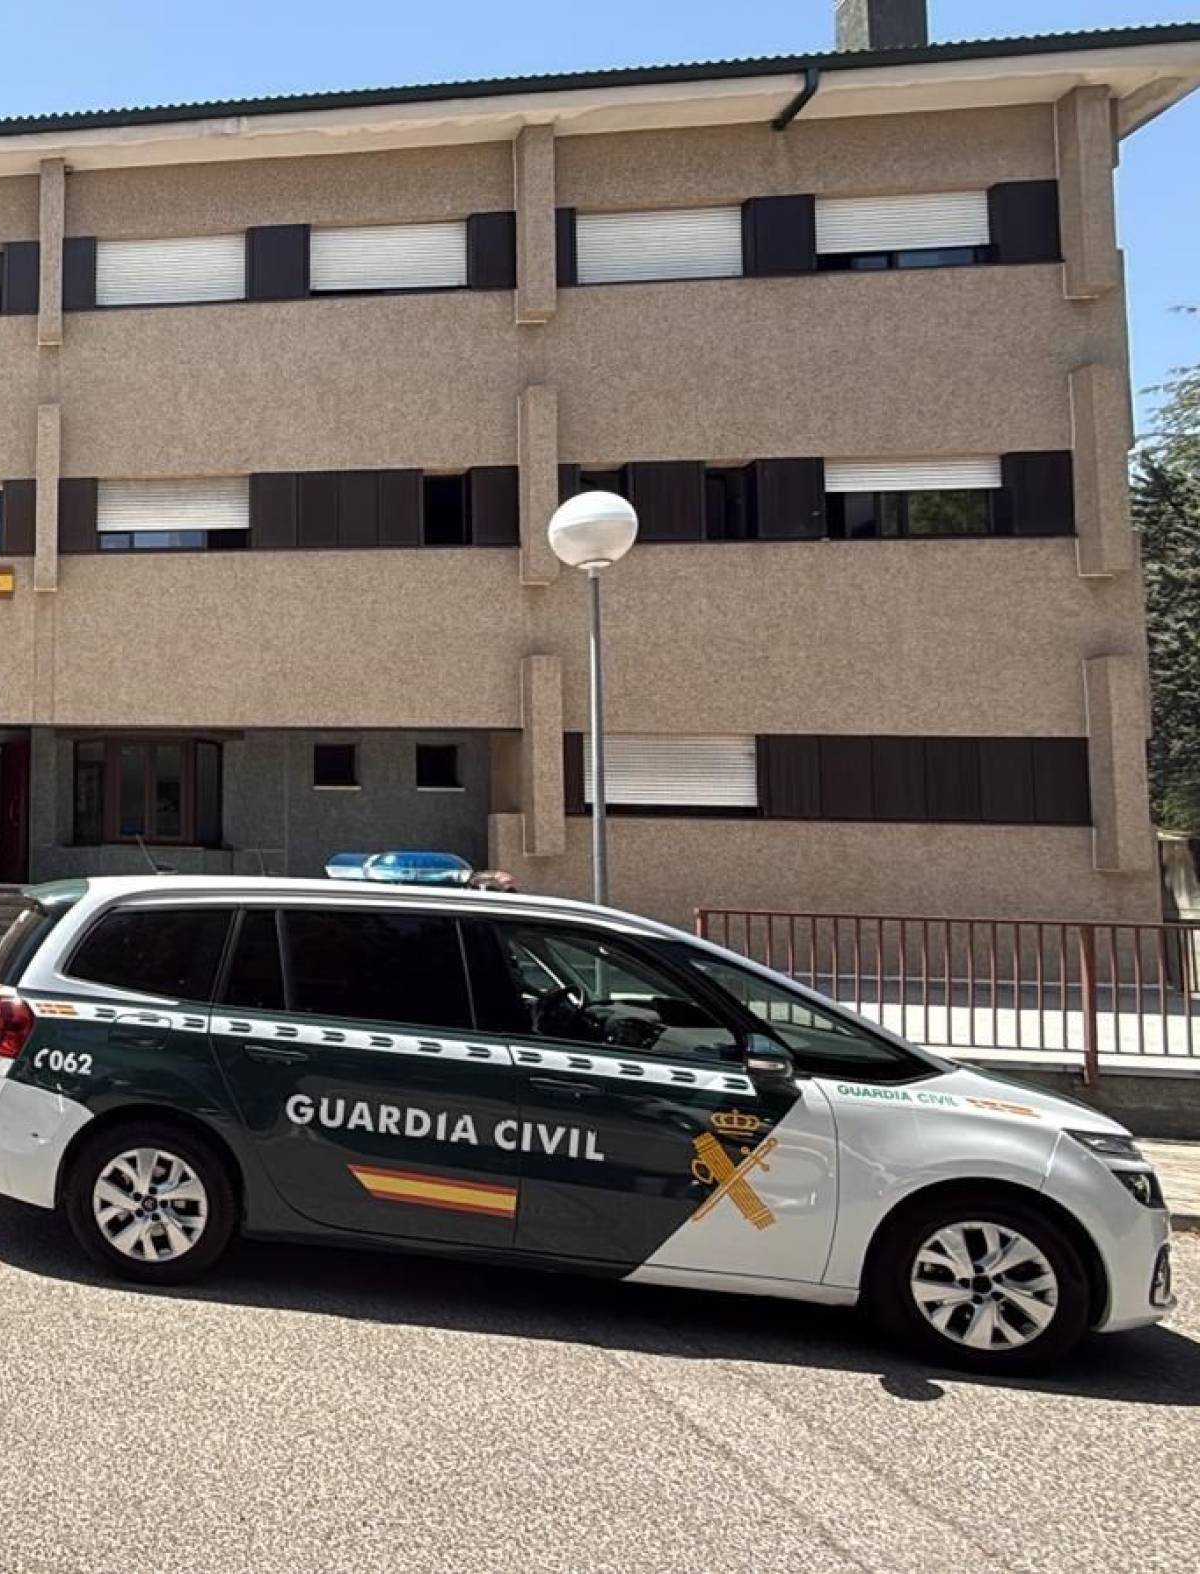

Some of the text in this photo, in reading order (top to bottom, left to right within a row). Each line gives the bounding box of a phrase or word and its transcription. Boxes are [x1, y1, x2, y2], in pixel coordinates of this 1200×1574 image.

[837, 1084, 960, 1107] GUARDIA CIVIL
[285, 1093, 605, 1162] GUARDIA CIVIL
